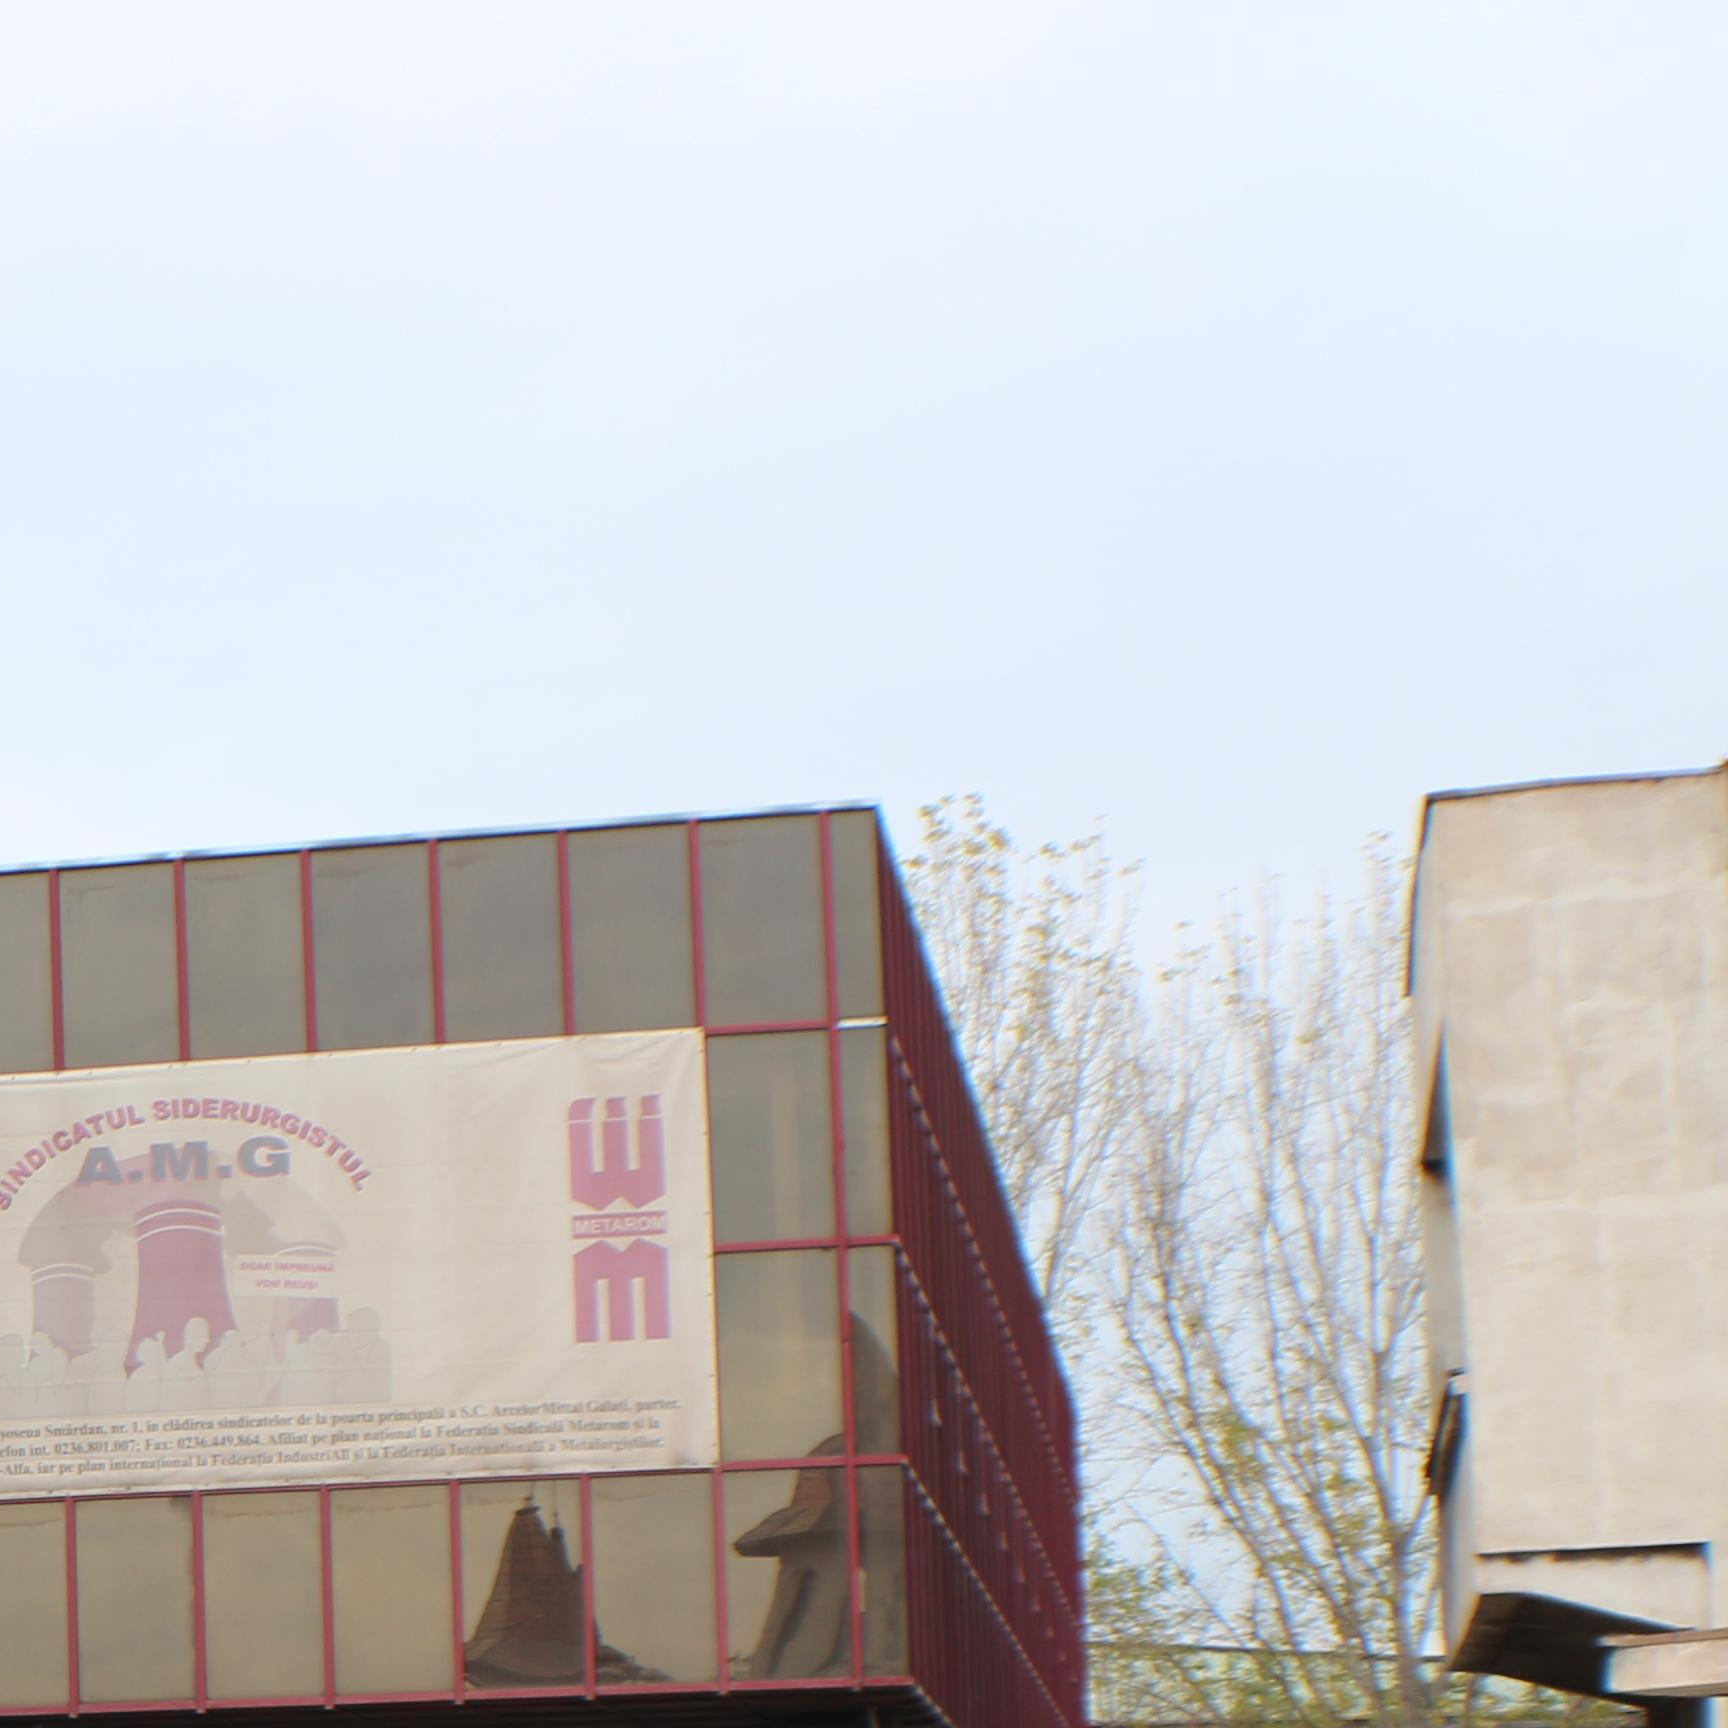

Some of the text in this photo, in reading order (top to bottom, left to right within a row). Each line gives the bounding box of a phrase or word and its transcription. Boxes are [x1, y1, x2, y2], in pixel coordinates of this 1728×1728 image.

[151, 1098, 372, 1192] SIDERURGISTUL
[75, 1135, 291, 1187] A.M.G
[574, 1215, 666, 1235] METAROM
[218, 1413, 292, 1429] sindicatelor
[297, 1414, 312, 1426] de
[316, 1413, 327, 1425] la
[331, 1430, 359, 1445] plan
[78, 1460, 105, 1475] plan
